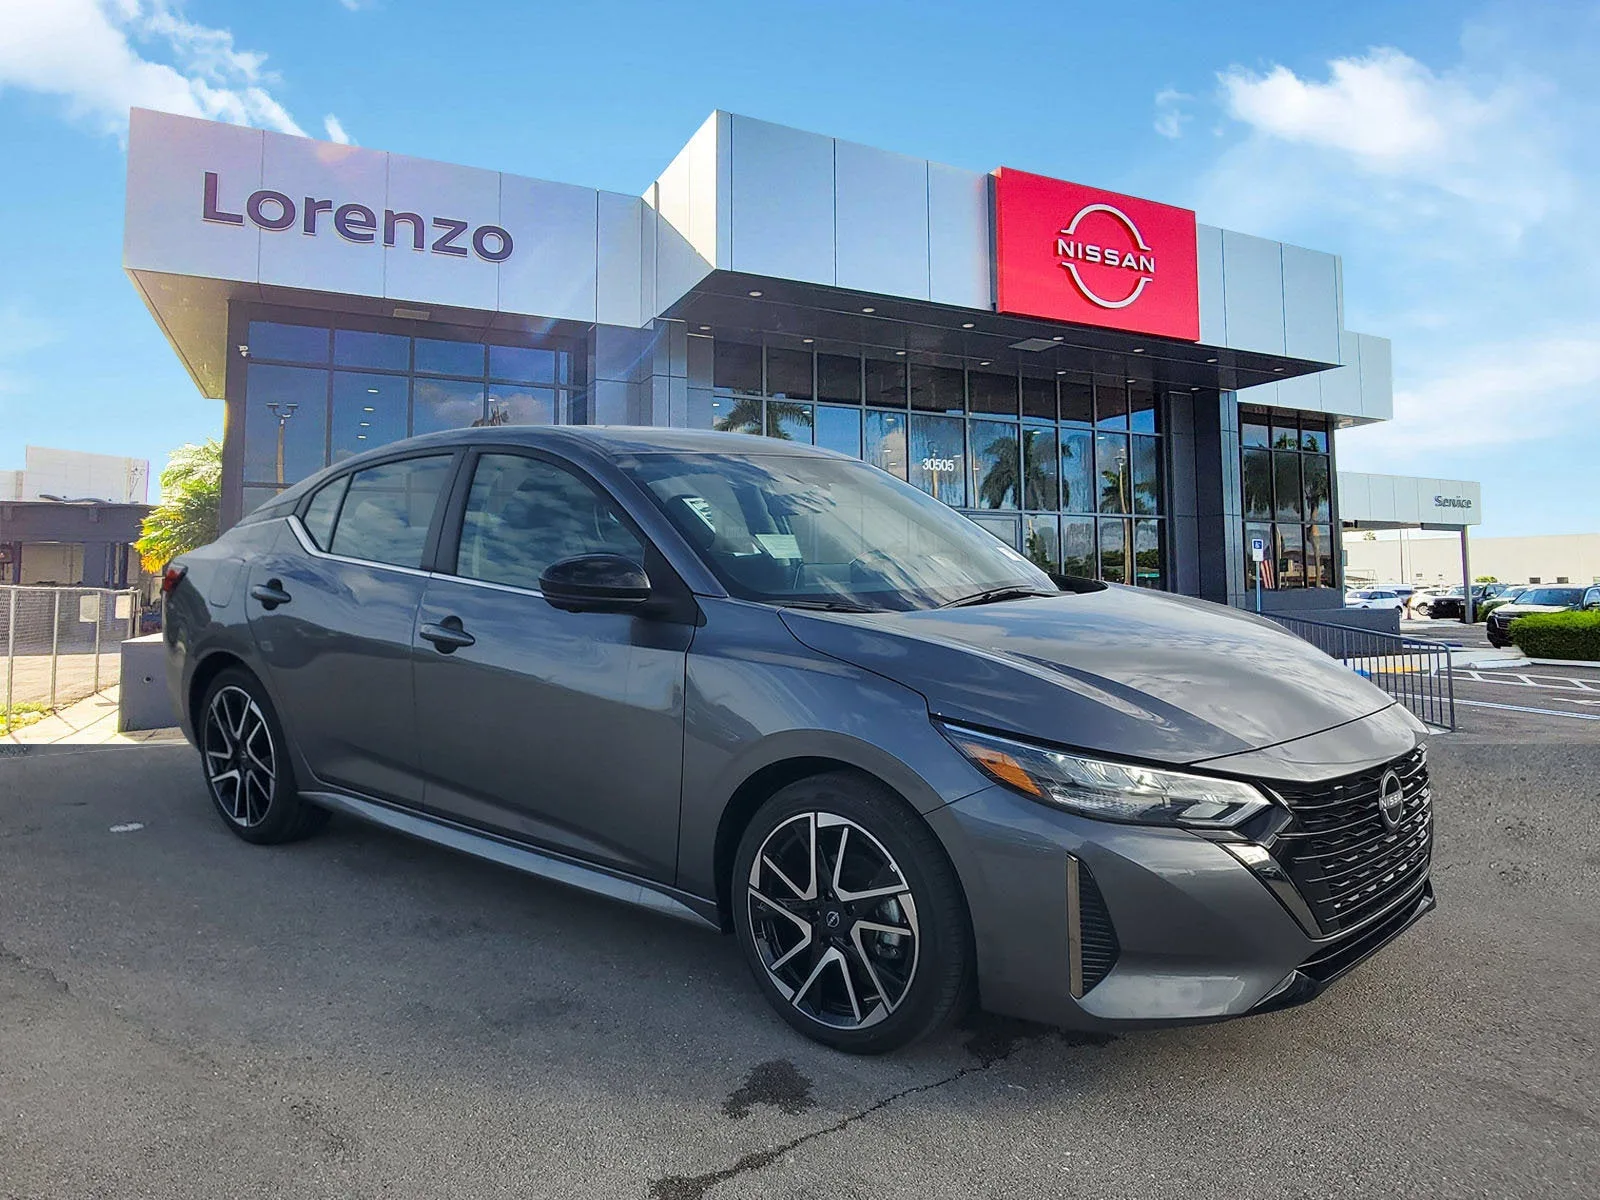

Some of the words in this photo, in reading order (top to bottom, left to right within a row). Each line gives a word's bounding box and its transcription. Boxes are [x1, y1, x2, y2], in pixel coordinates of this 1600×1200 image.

[202, 171, 514, 262] Lorenzo
[1057, 238, 1154, 273] NISSAN
[922, 458, 954, 471] 30505
[1434, 495, 1472, 508] Service
